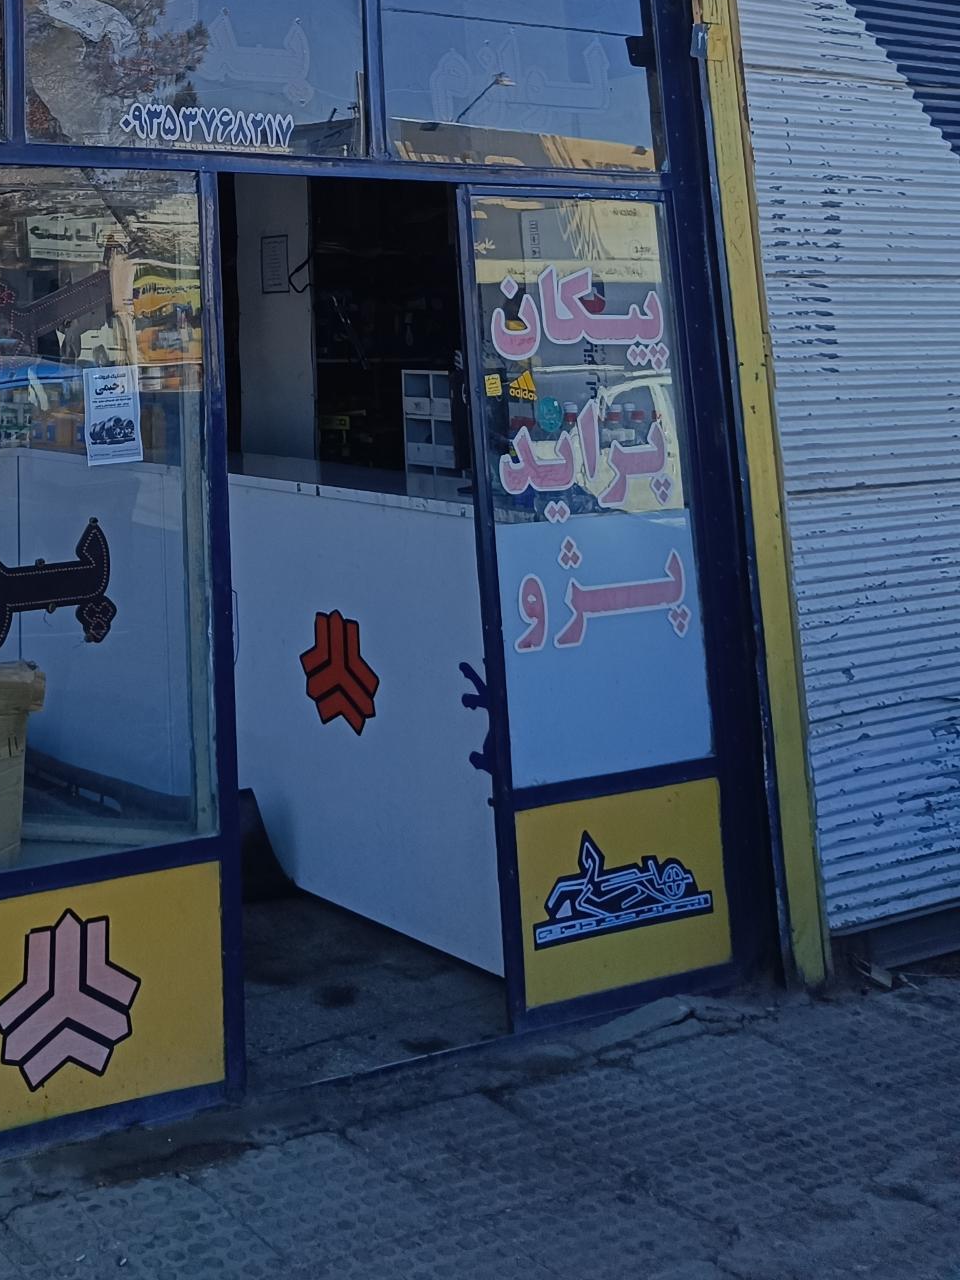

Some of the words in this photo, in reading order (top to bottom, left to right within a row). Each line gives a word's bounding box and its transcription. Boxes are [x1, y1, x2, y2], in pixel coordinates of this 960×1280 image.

[119, 102, 295, 148] ۰۹۳۵۳۷۶۸۲۱۷
[491, 264, 670, 370] پیکان
[94, 381, 126, 396] رحیمی
[499, 398, 672, 522] پراید
[513, 536, 691, 654] پژو
